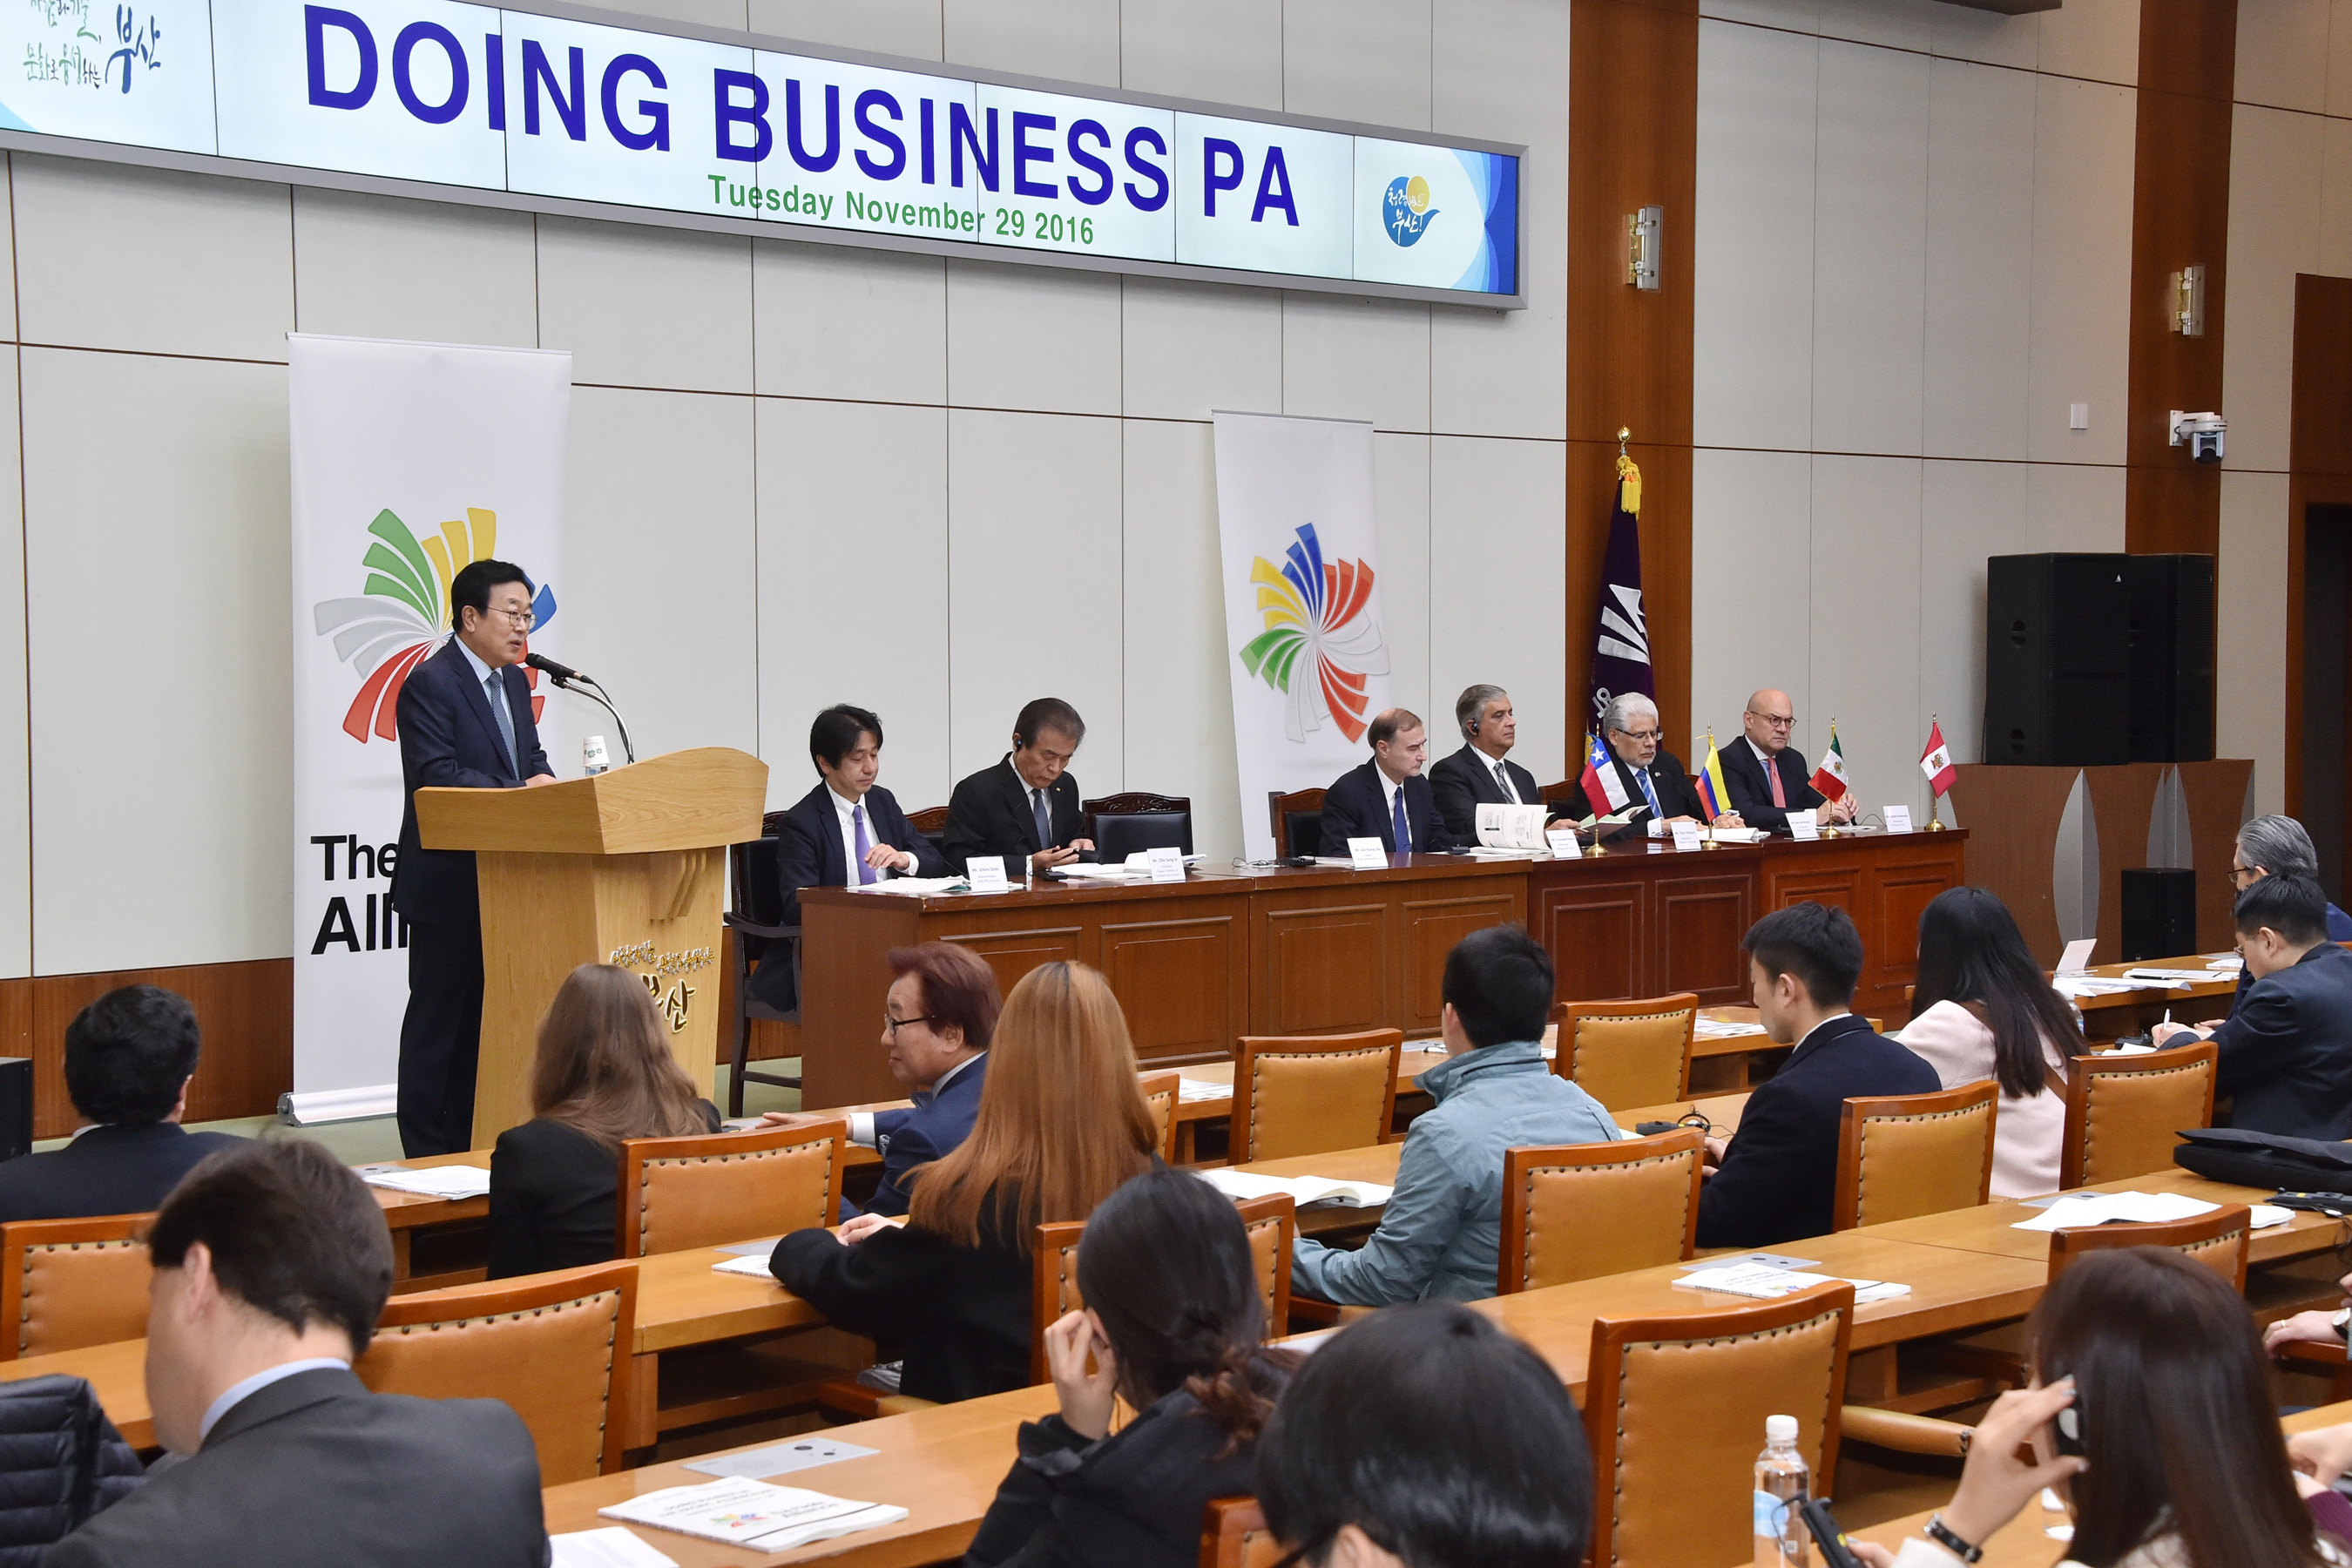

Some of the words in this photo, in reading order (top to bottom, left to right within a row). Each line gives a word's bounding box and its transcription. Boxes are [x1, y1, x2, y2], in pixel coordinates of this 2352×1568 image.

[105, 3, 161, 94] 부산
[305, 4, 670, 152] DOING
[713, 68, 1169, 212] BUSINESS
[1204, 137, 1299, 226] PA
[707, 174, 833, 220] Tuesday
[846, 191, 985, 233] November
[996, 208, 1024, 237] 29
[1035, 212, 1093, 245] 2016
[1392, 208, 1423, 245] 부산!
[310, 834, 398, 881] The
